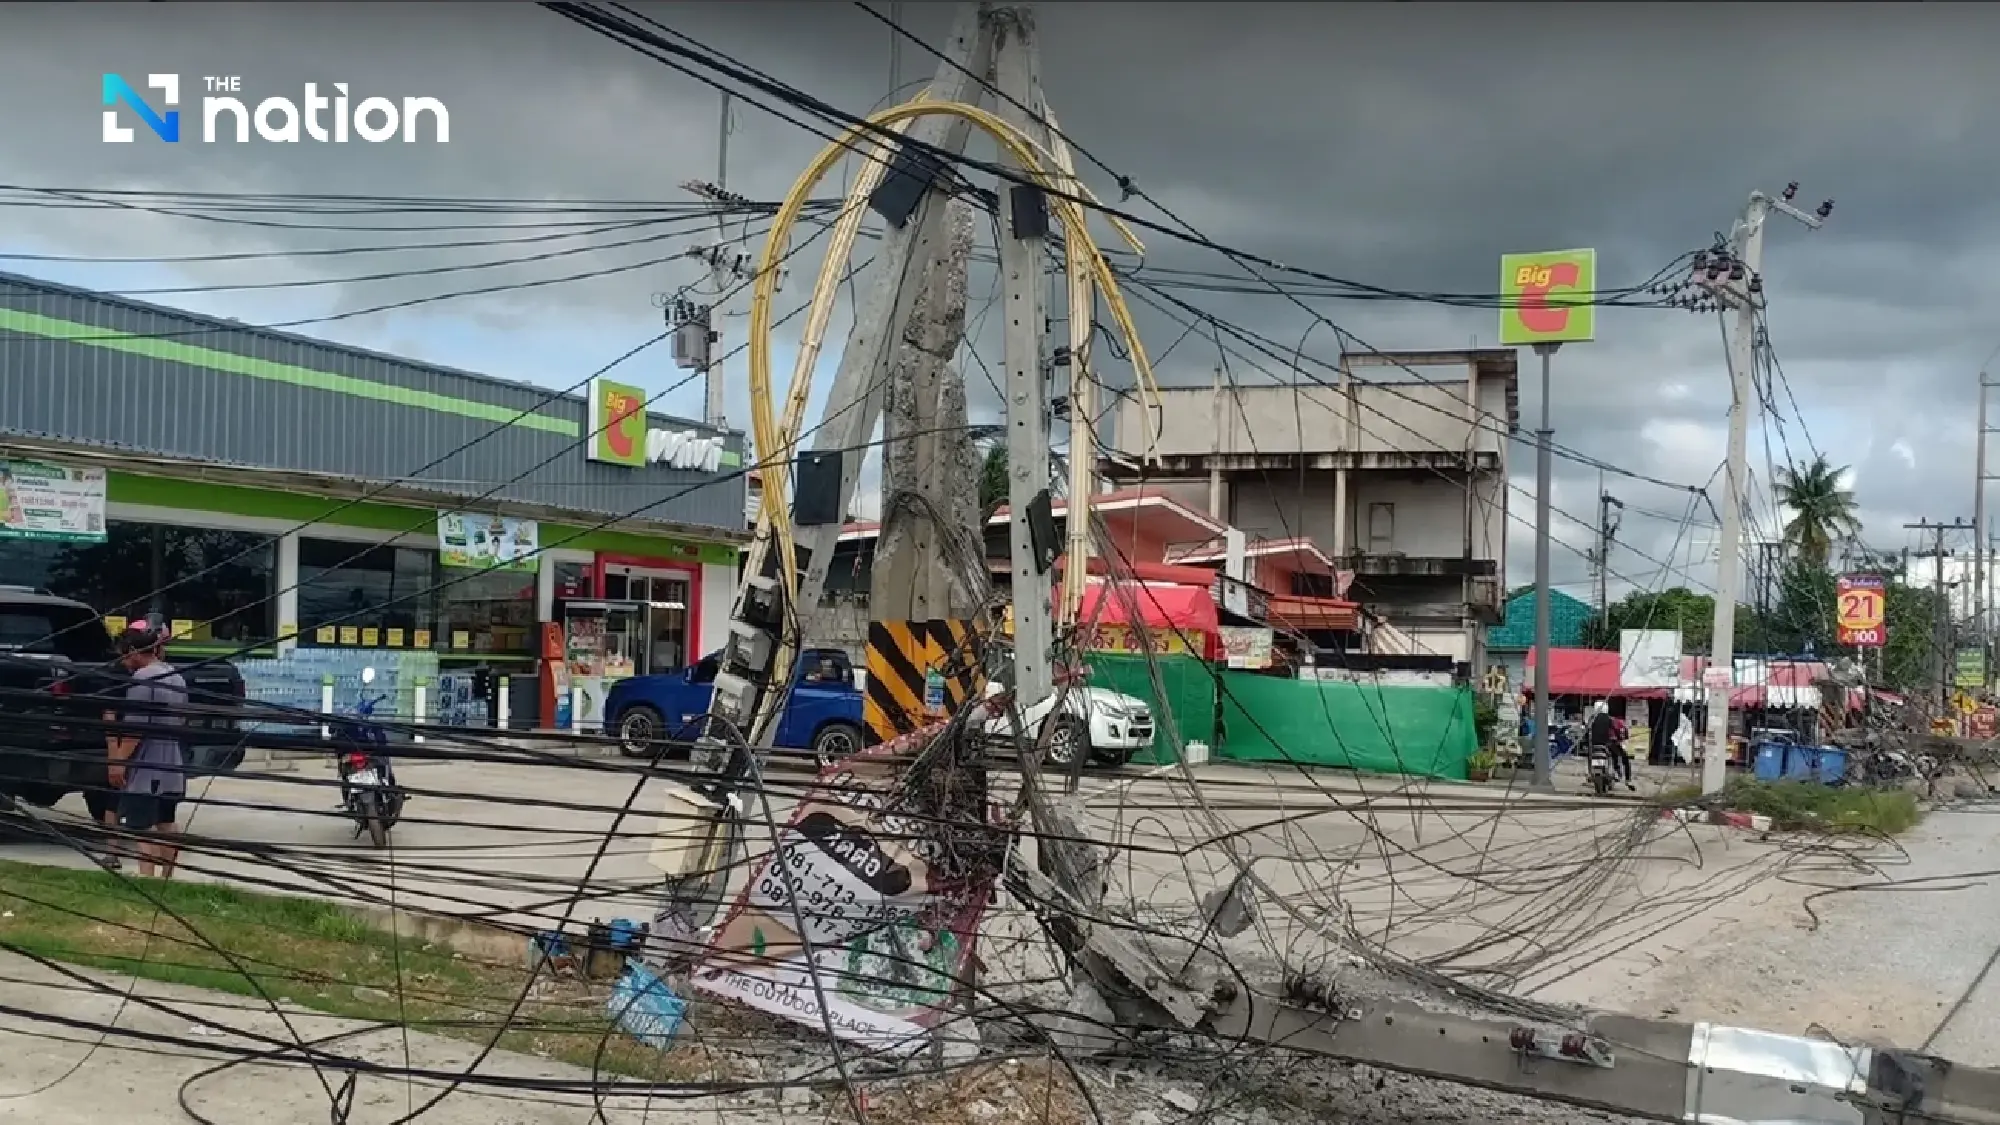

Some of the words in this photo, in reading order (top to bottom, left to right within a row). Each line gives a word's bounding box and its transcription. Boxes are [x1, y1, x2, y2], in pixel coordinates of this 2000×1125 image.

[1515, 265, 1552, 288] Big
[1517, 261, 1581, 333] C
[606, 391, 627, 414] Big
[607, 396, 640, 458] C
[1844, 595, 1874, 618] 21
[725, 973, 751, 991] THE
